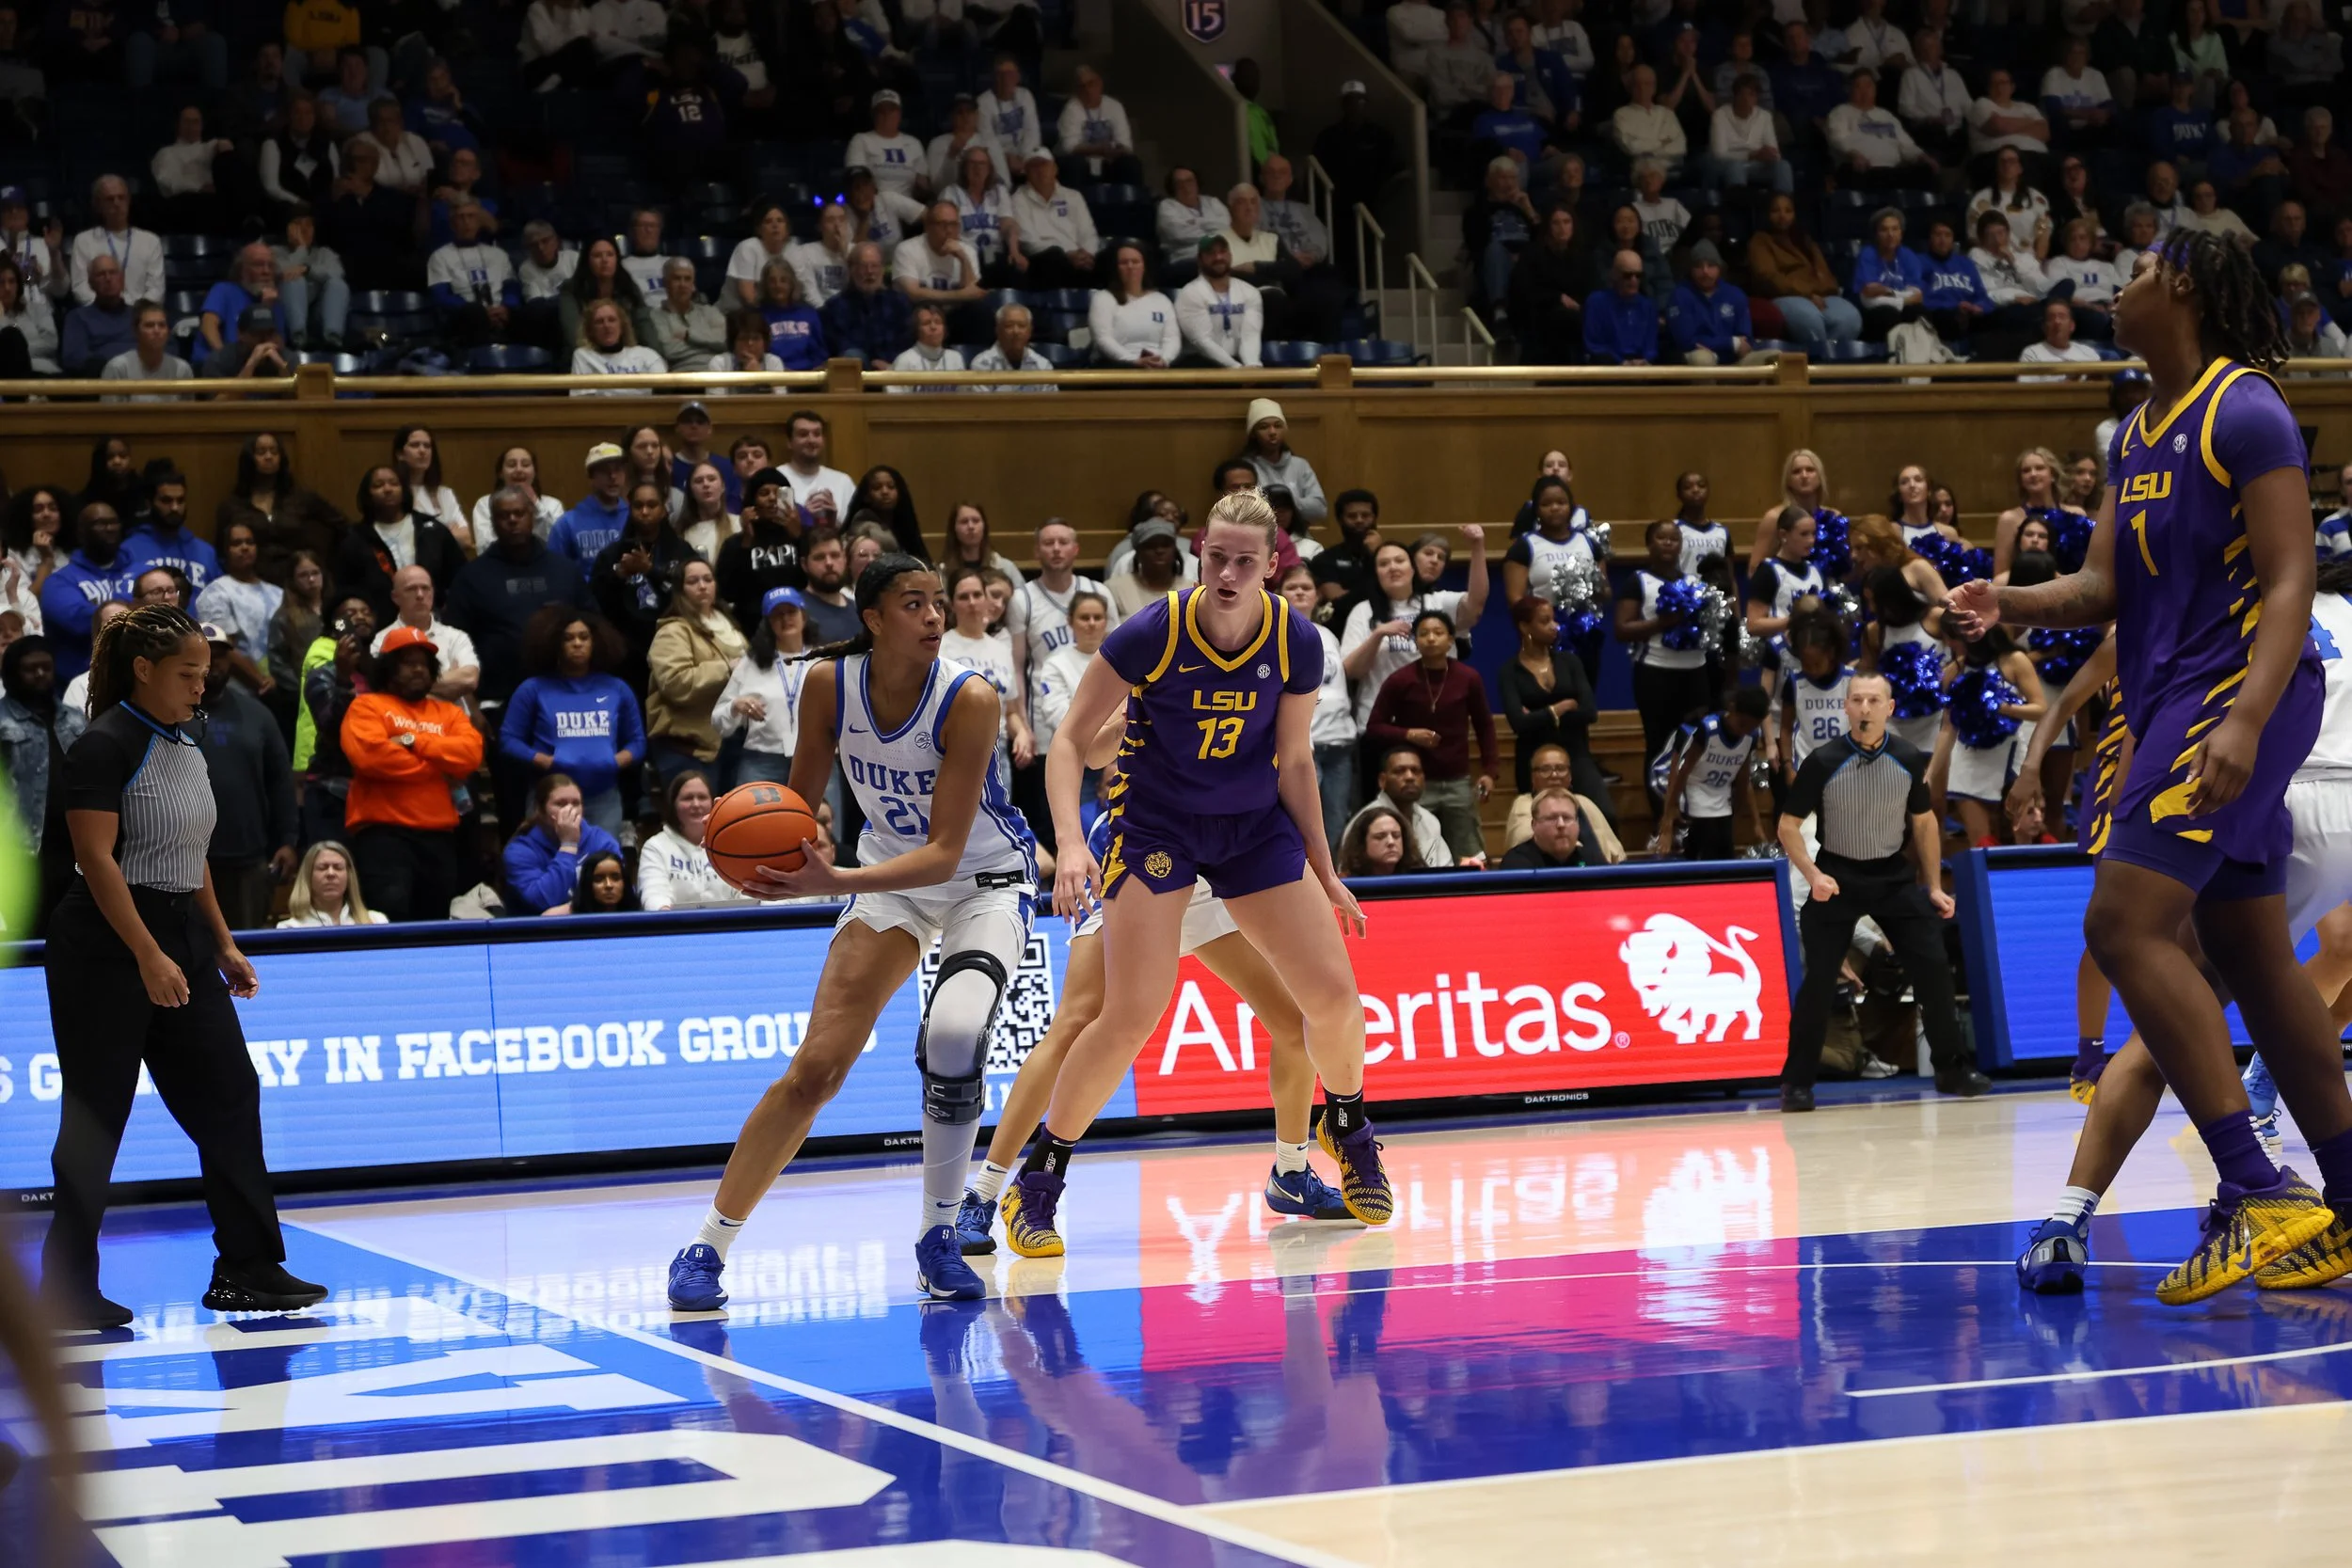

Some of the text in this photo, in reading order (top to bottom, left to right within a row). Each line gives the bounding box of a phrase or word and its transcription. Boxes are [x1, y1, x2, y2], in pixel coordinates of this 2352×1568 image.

[1191, 3, 1221, 31] 15
[2120, 470, 2172, 504] LSU
[2130, 509, 2160, 577] 1
[1192, 689, 1258, 712] LSU
[1805, 698, 1845, 710] DUKE
[556, 710, 610, 730] DUKE
[1813, 717, 1840, 740] 26
[1197, 717, 1246, 760] 13
[849, 754, 936, 796] DUKE
[1707, 770, 1732, 788] 26
[879, 797, 929, 836] 21
[324, 1035, 383, 1085] IN
[395, 1020, 667, 1081] FACEBOOK
[1524, 1092, 1589, 1104] DAKTRONICS
